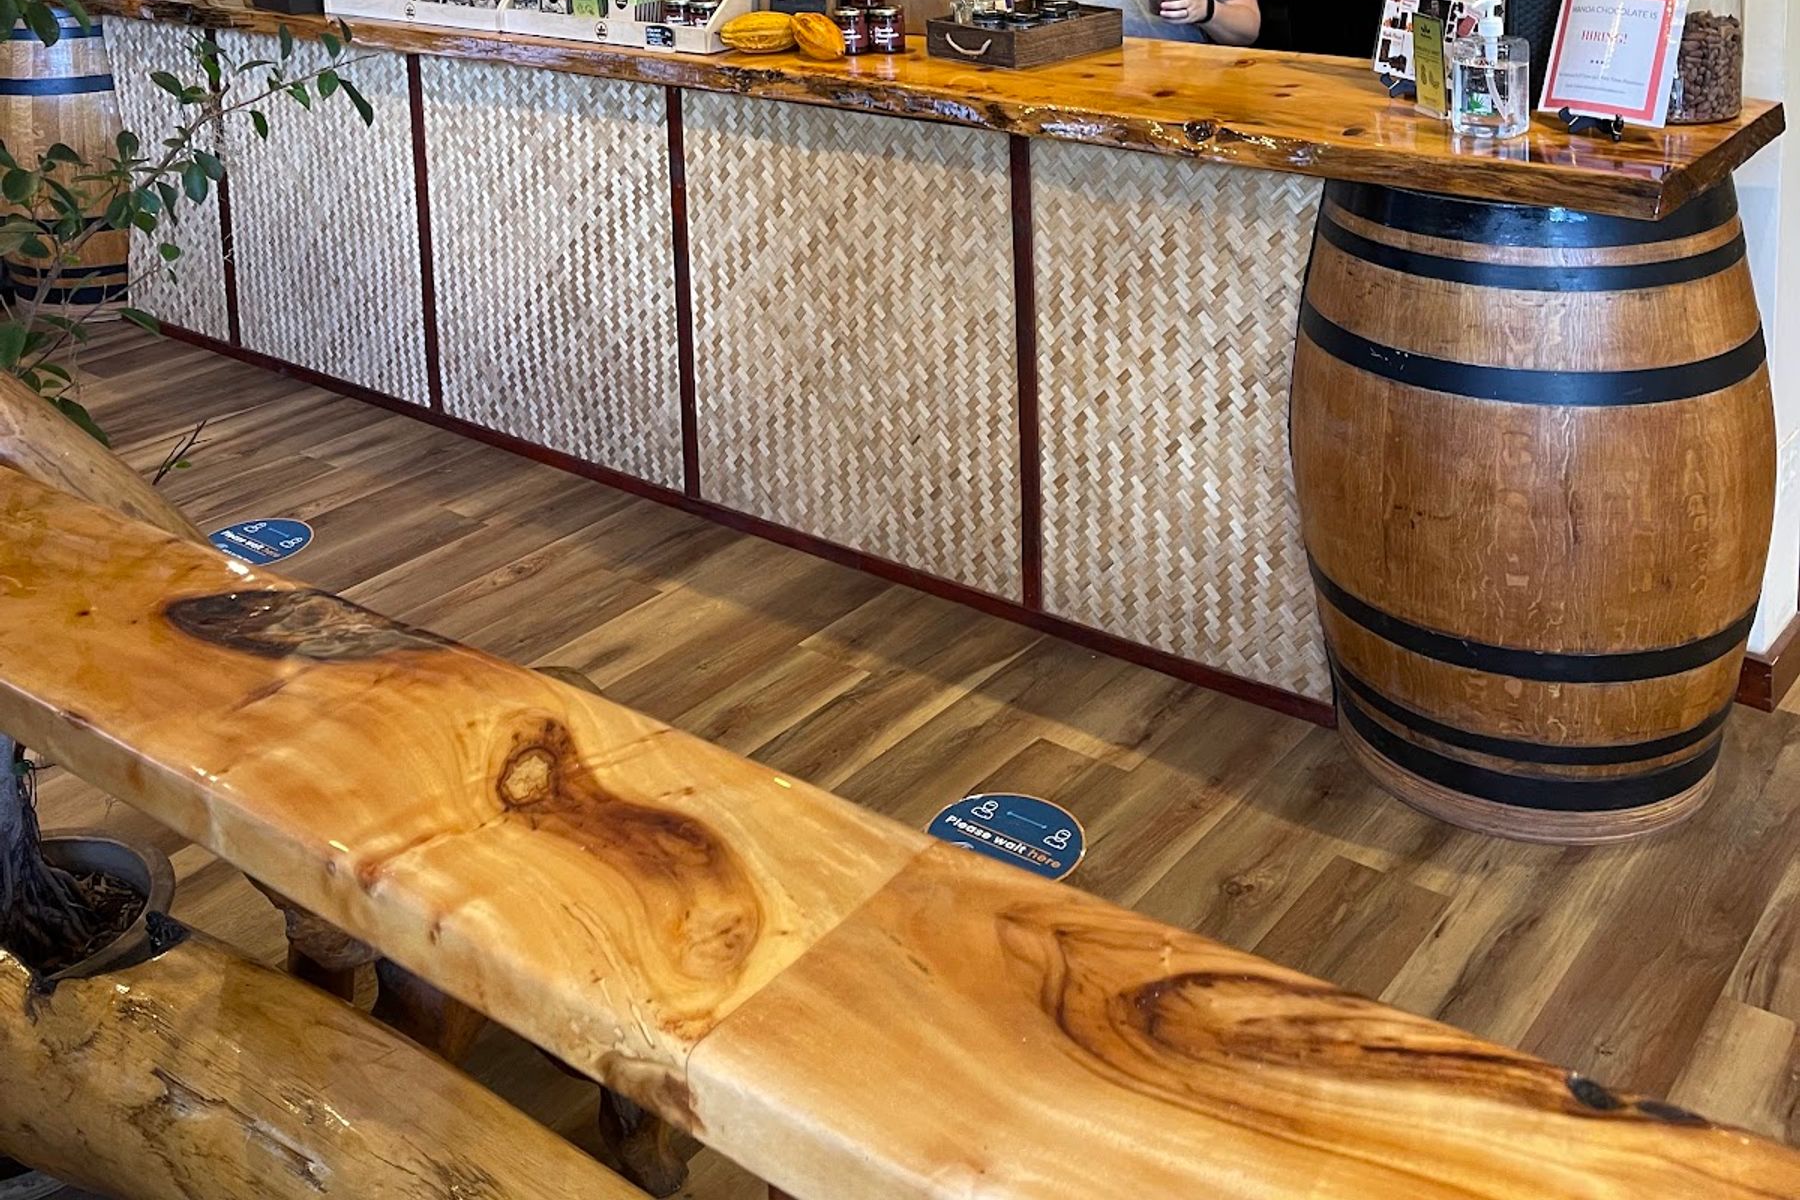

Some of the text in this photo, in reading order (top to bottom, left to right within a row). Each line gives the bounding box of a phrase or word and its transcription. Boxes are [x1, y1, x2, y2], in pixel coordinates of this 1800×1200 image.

[1649, 10, 1658, 19] IS
[945, 814, 1062, 869] Please wait here
